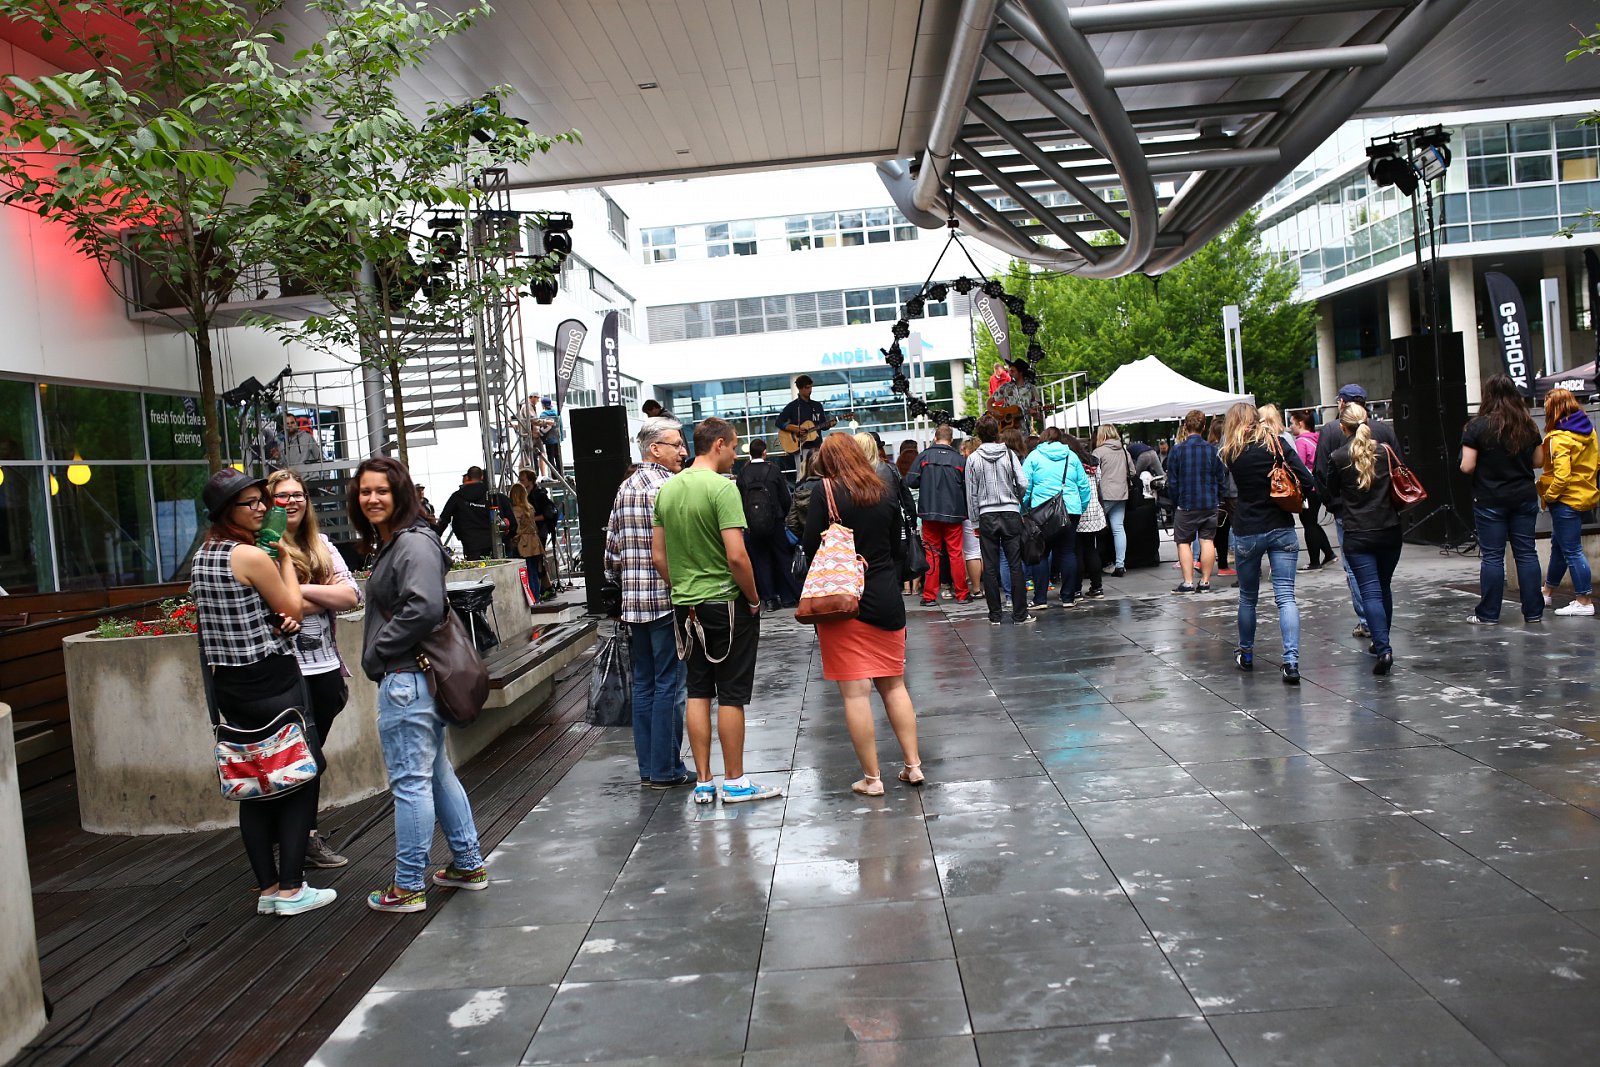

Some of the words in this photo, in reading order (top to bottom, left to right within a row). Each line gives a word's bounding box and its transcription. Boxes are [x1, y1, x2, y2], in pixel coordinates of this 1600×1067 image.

[558, 329, 583, 379] STALLIONS
[1499, 301, 1528, 389] G-SHOCK
[604, 337, 619, 406] G-SHOC
[150, 409, 169, 424] fresh
[170, 411, 185, 425] food
[186, 412, 201, 426] take
[174, 431, 202, 447] catering
